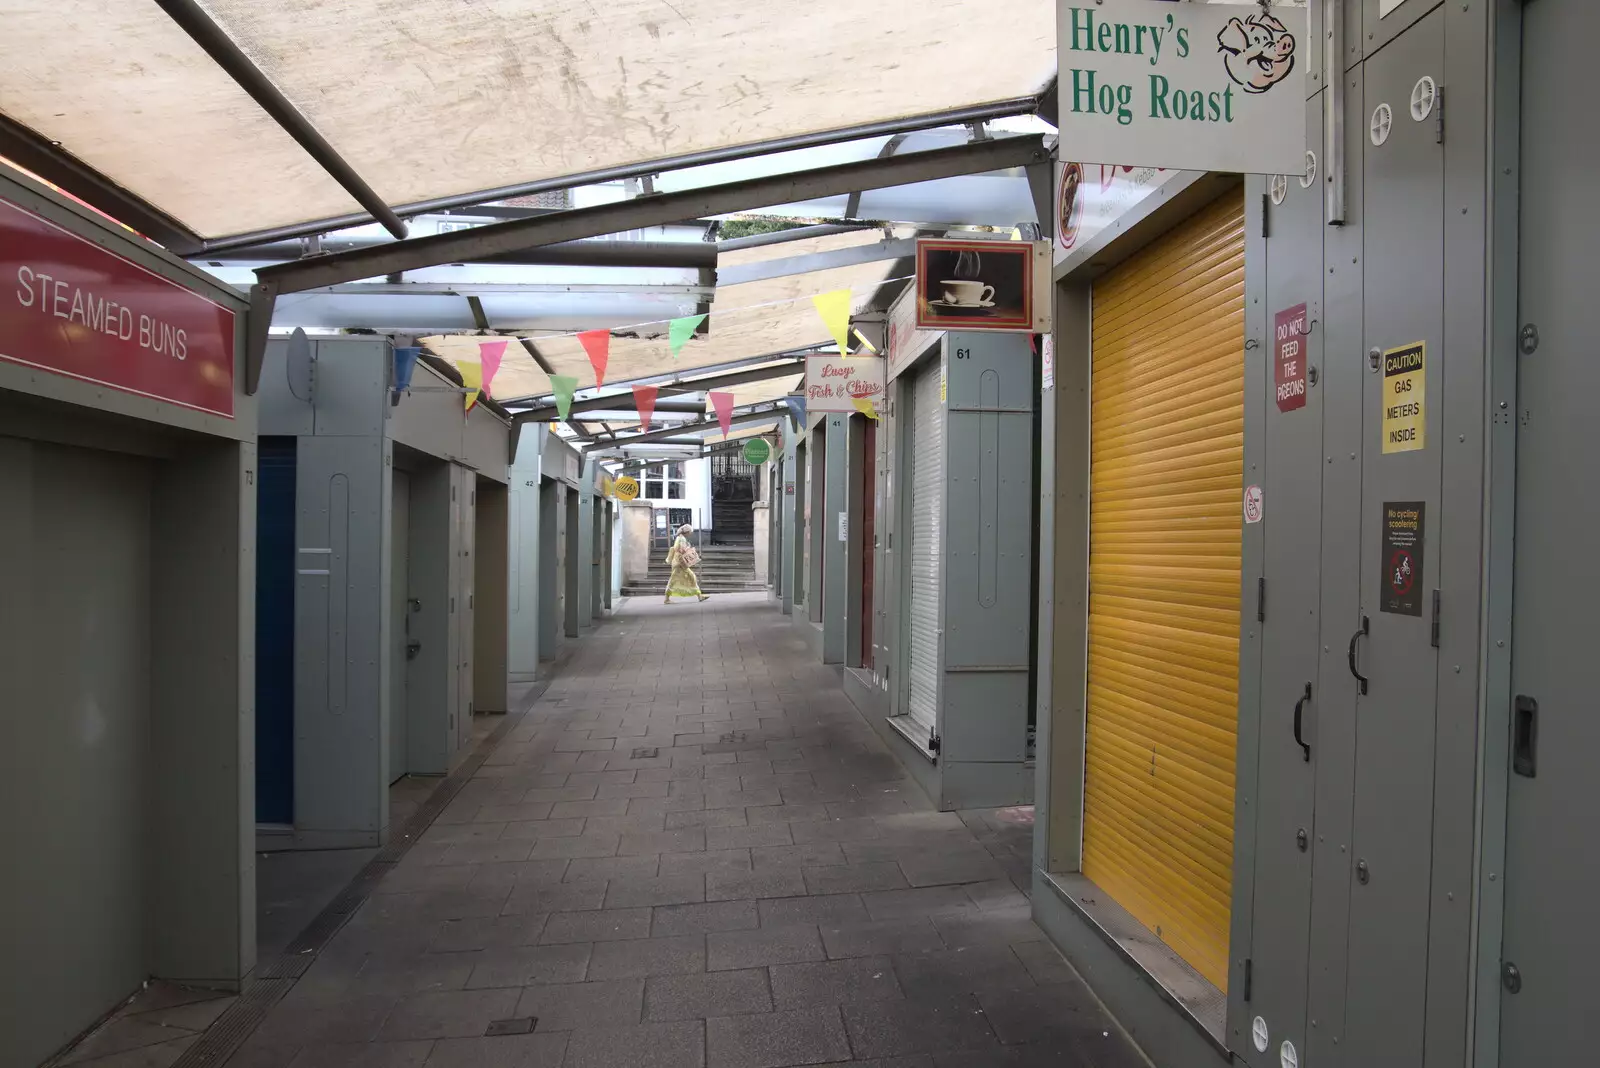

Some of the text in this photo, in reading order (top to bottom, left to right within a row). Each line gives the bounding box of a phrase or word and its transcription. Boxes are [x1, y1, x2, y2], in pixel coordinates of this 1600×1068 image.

[1069, 69, 1235, 125] Hog Roast
[17, 265, 187, 360] STEAMED BUNS
[1277, 318, 1303, 341] DO NOT
[956, 349, 970, 359] 61
[1281, 340, 1298, 359] FEED
[1283, 361, 1297, 378] THE
[1386, 351, 1421, 372] CAUTION
[821, 364, 855, 379] Lucys
[808, 380, 882, 399] Fish & Chips
[1394, 379, 1412, 394] GAS
[1386, 402, 1419, 420] METERS
[1389, 428, 1416, 443] INSIDE
[1388, 509, 1396, 518] No
[1388, 519, 1418, 530] scootering
